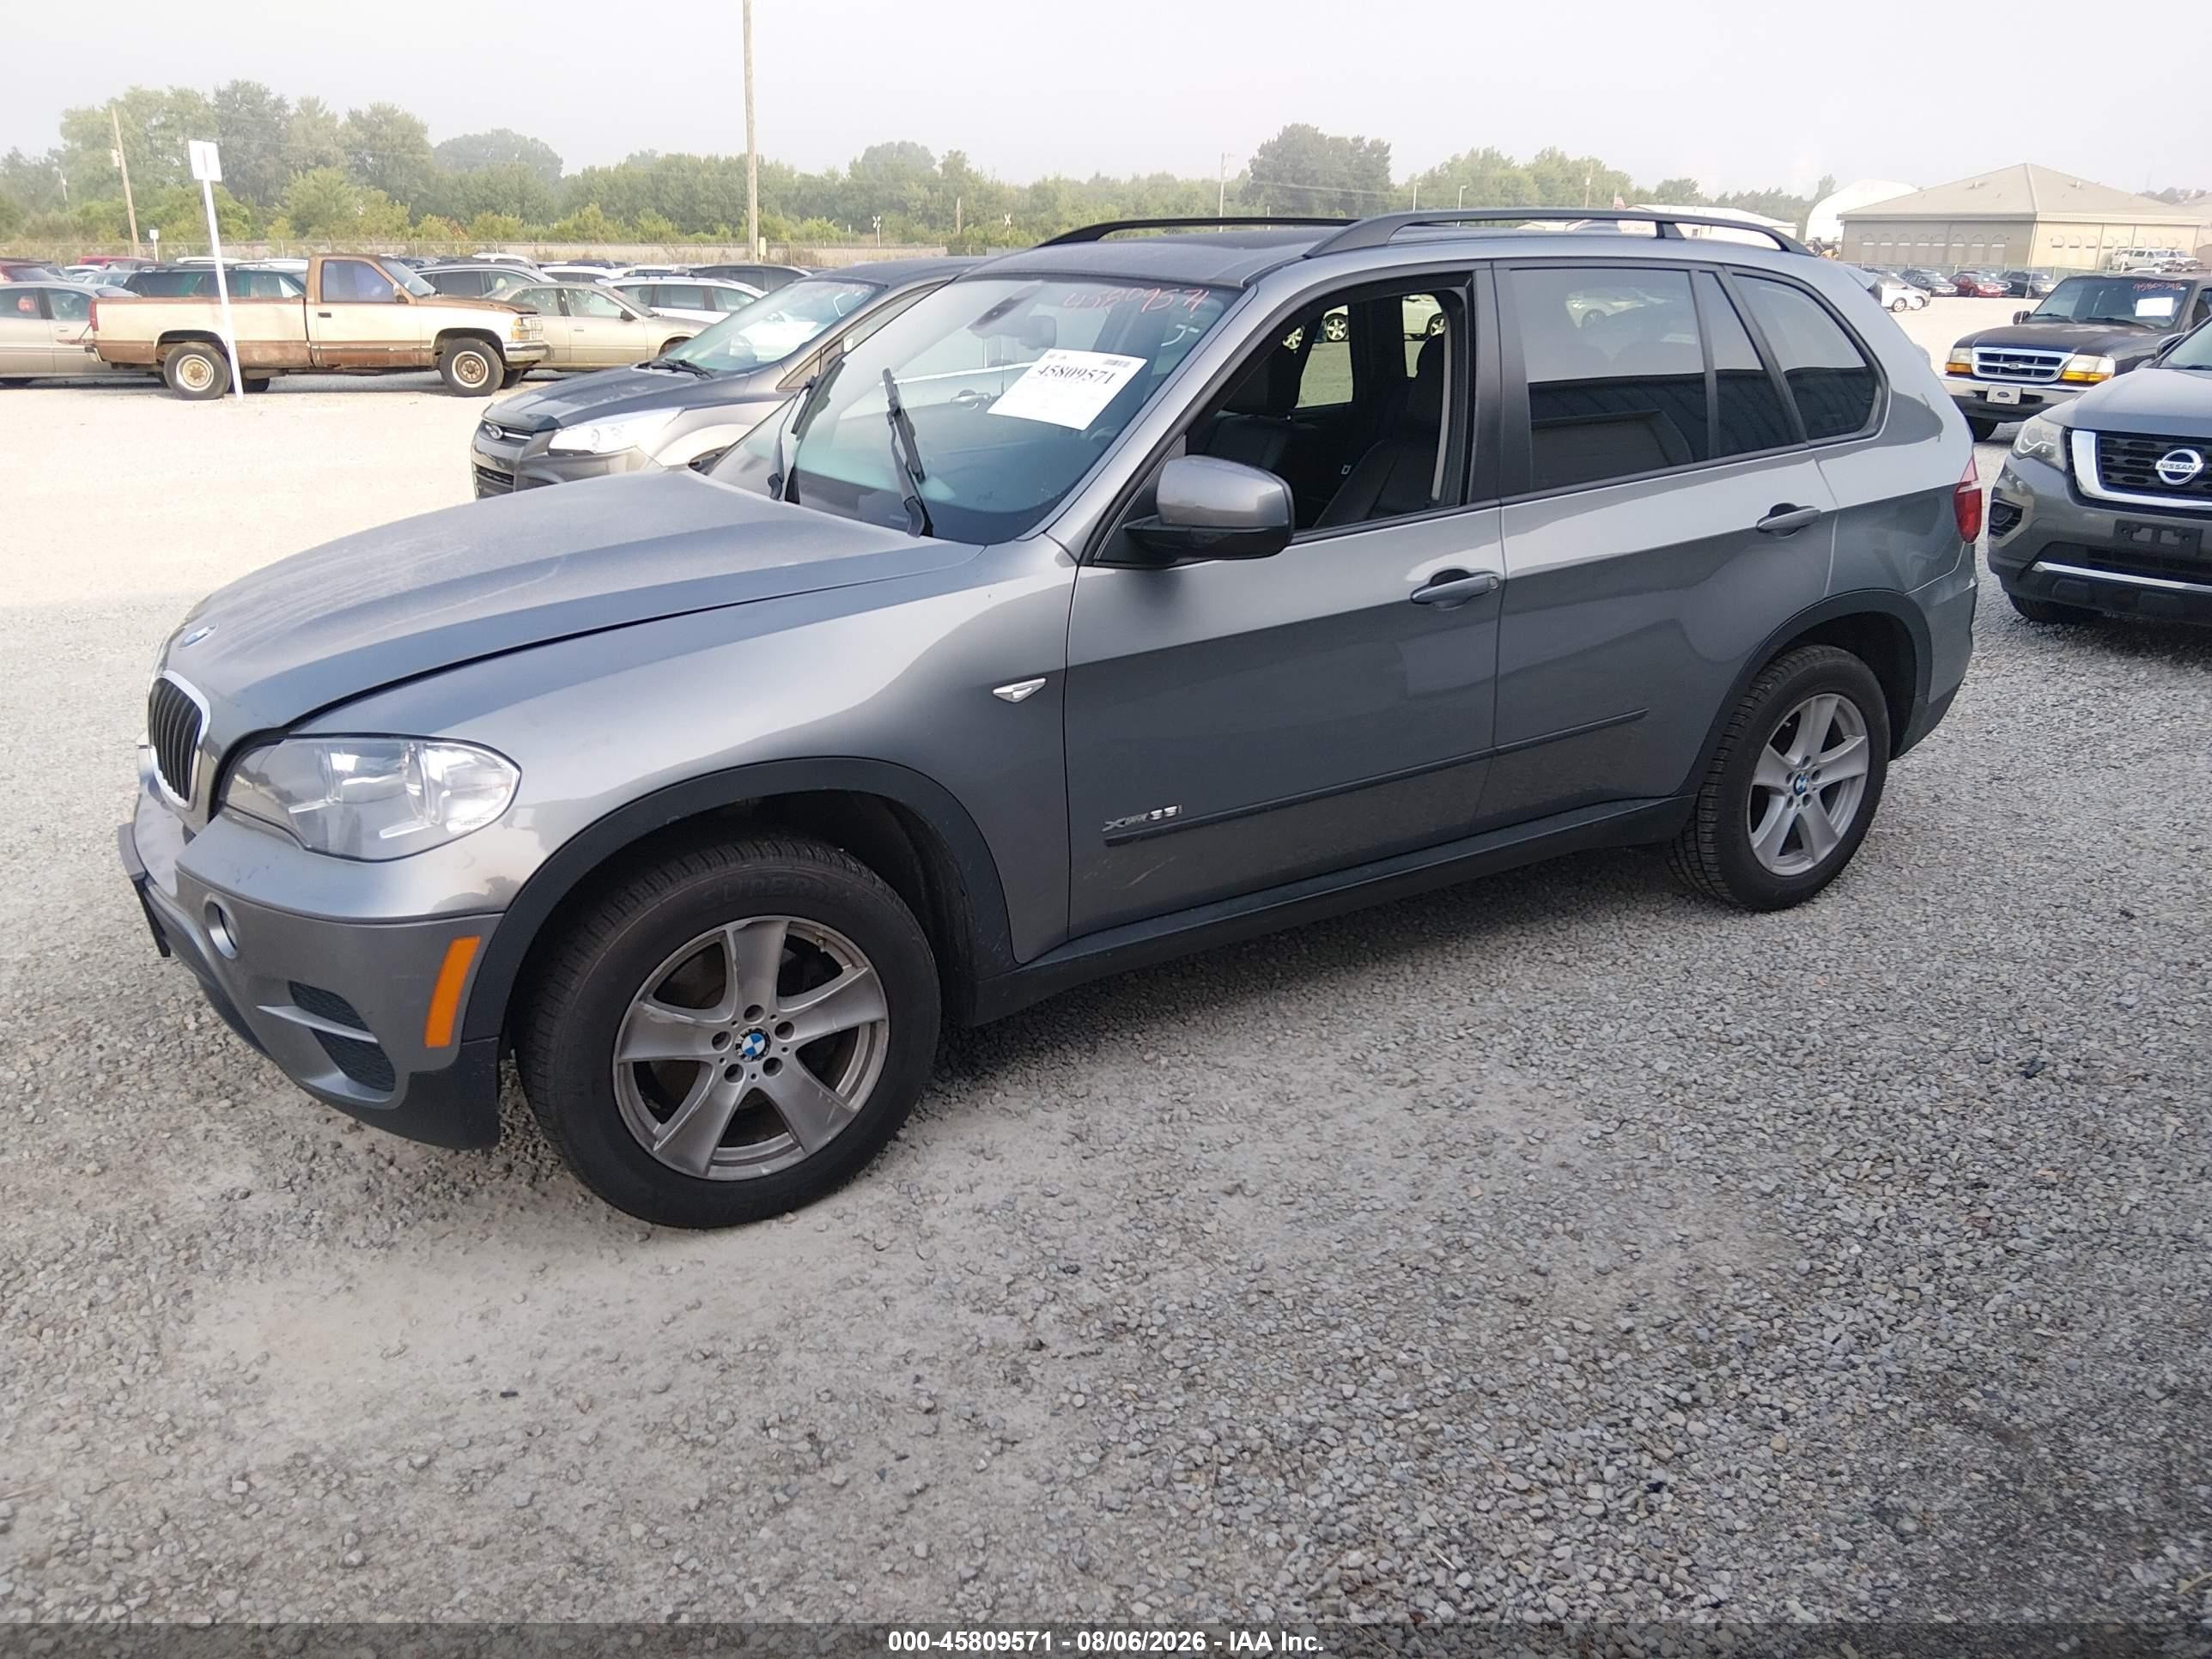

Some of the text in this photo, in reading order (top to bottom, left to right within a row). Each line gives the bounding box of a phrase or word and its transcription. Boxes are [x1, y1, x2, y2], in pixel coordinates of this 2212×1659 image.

[1063, 287, 1210, 313] 45809571
[1037, 363, 1117, 385] 45809571
[2159, 462, 2197, 471] NISSAN
